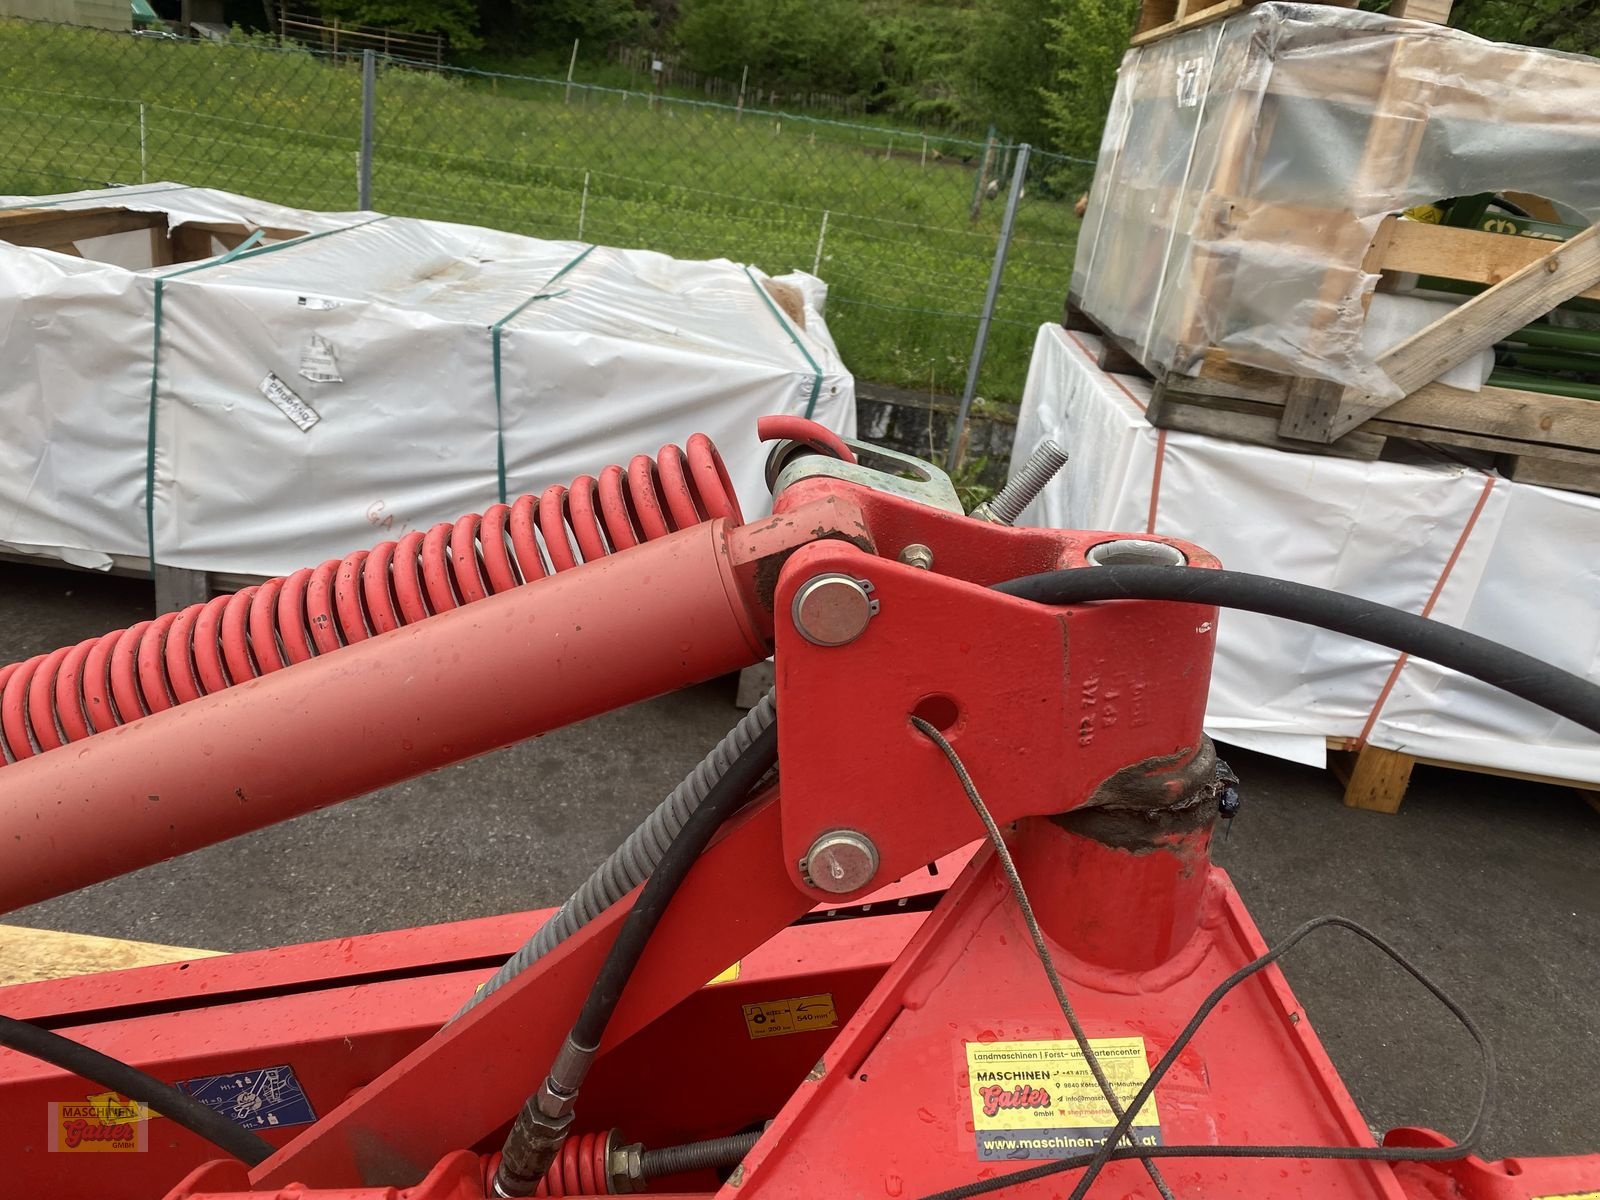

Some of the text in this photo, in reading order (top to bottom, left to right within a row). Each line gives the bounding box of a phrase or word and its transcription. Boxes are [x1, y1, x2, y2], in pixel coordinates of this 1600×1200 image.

[974, 1052, 1038, 1061] Landmaschinen
[1044, 1051, 1069, 1059] Forst-
[1094, 1048, 1141, 1057] artencenter
[977, 1071, 1050, 1081] MASCHINEN
